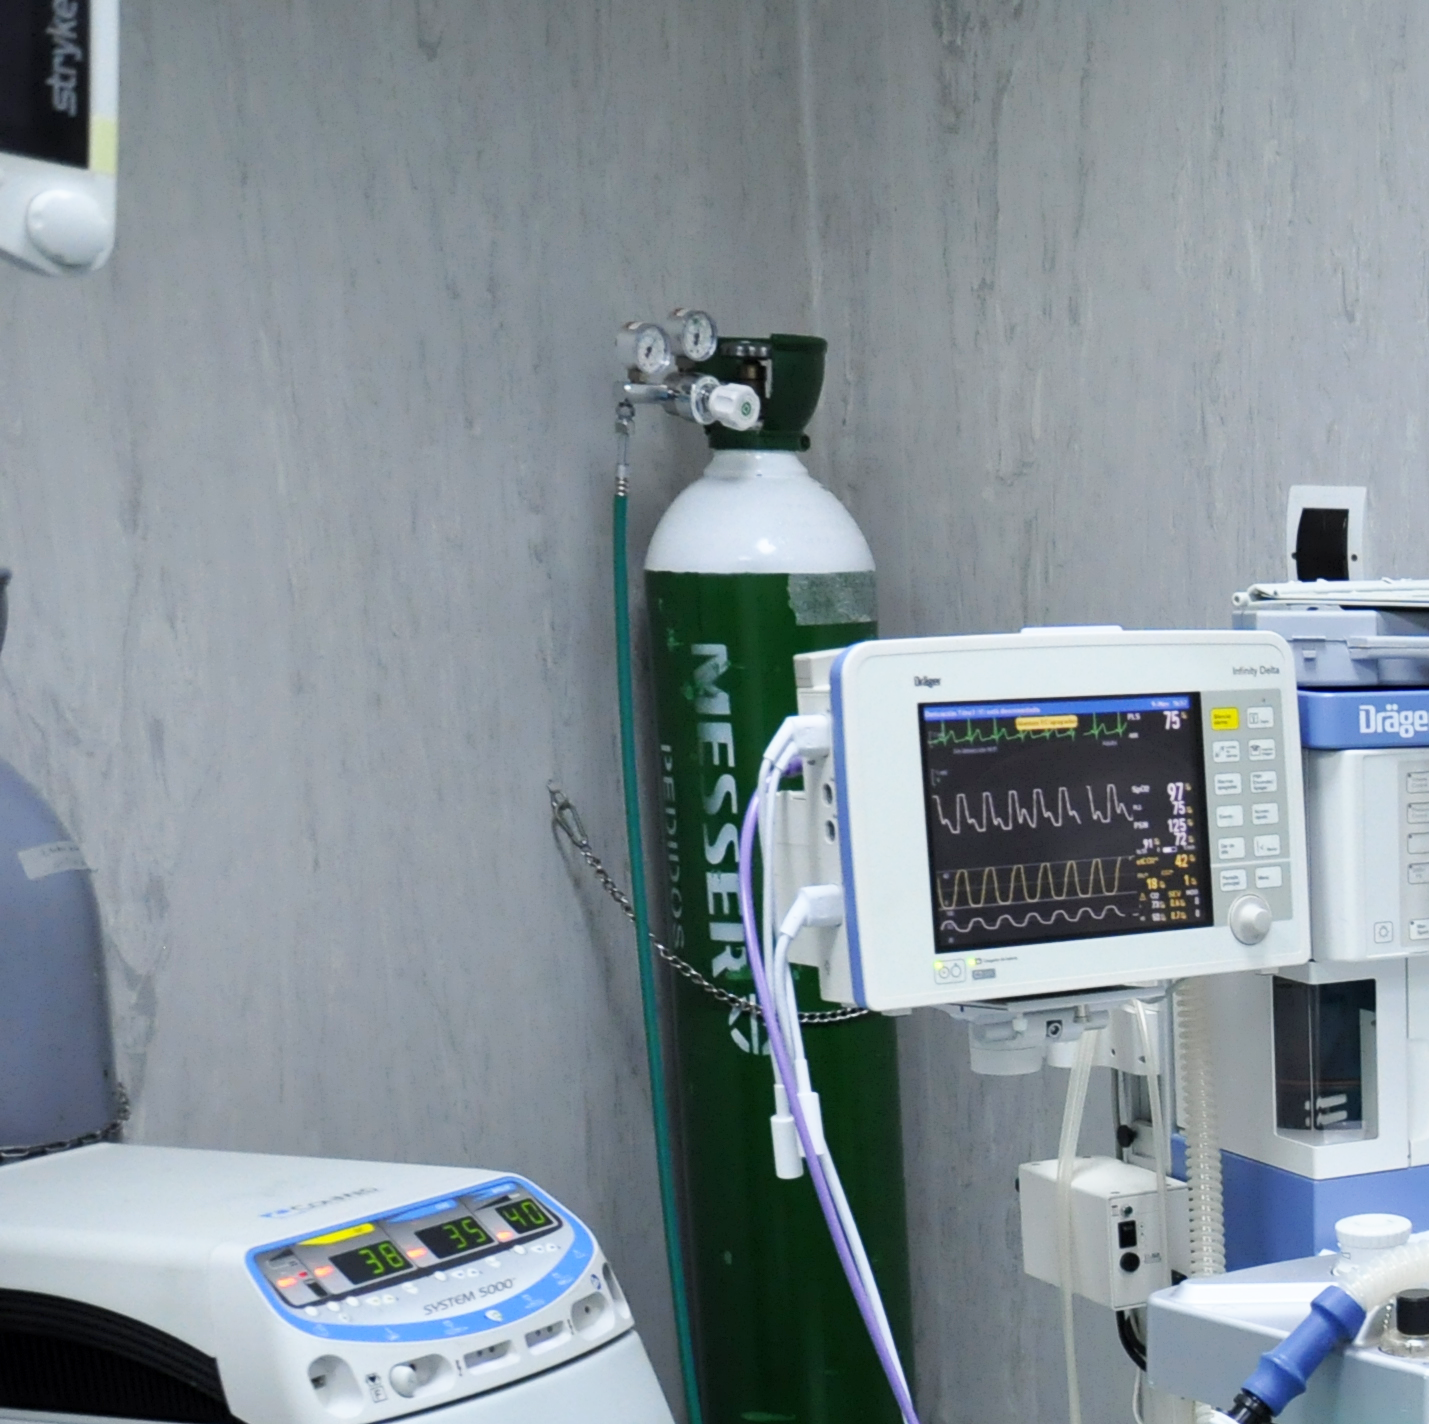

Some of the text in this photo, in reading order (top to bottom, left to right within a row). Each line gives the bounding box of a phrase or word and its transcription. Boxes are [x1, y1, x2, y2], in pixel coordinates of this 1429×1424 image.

[1232, 665, 1280, 677] Infinity Delta
[1163, 710, 1181, 730] 75
[1167, 782, 1184, 802] 97
[691, 643, 748, 977] MESSER
[1172, 800, 1186, 815] 75
[1167, 818, 1187, 833] 125
[357, 1200, 546, 1275] 38 35 40
[423, 1278, 514, 1316] SYSTEM 5000
